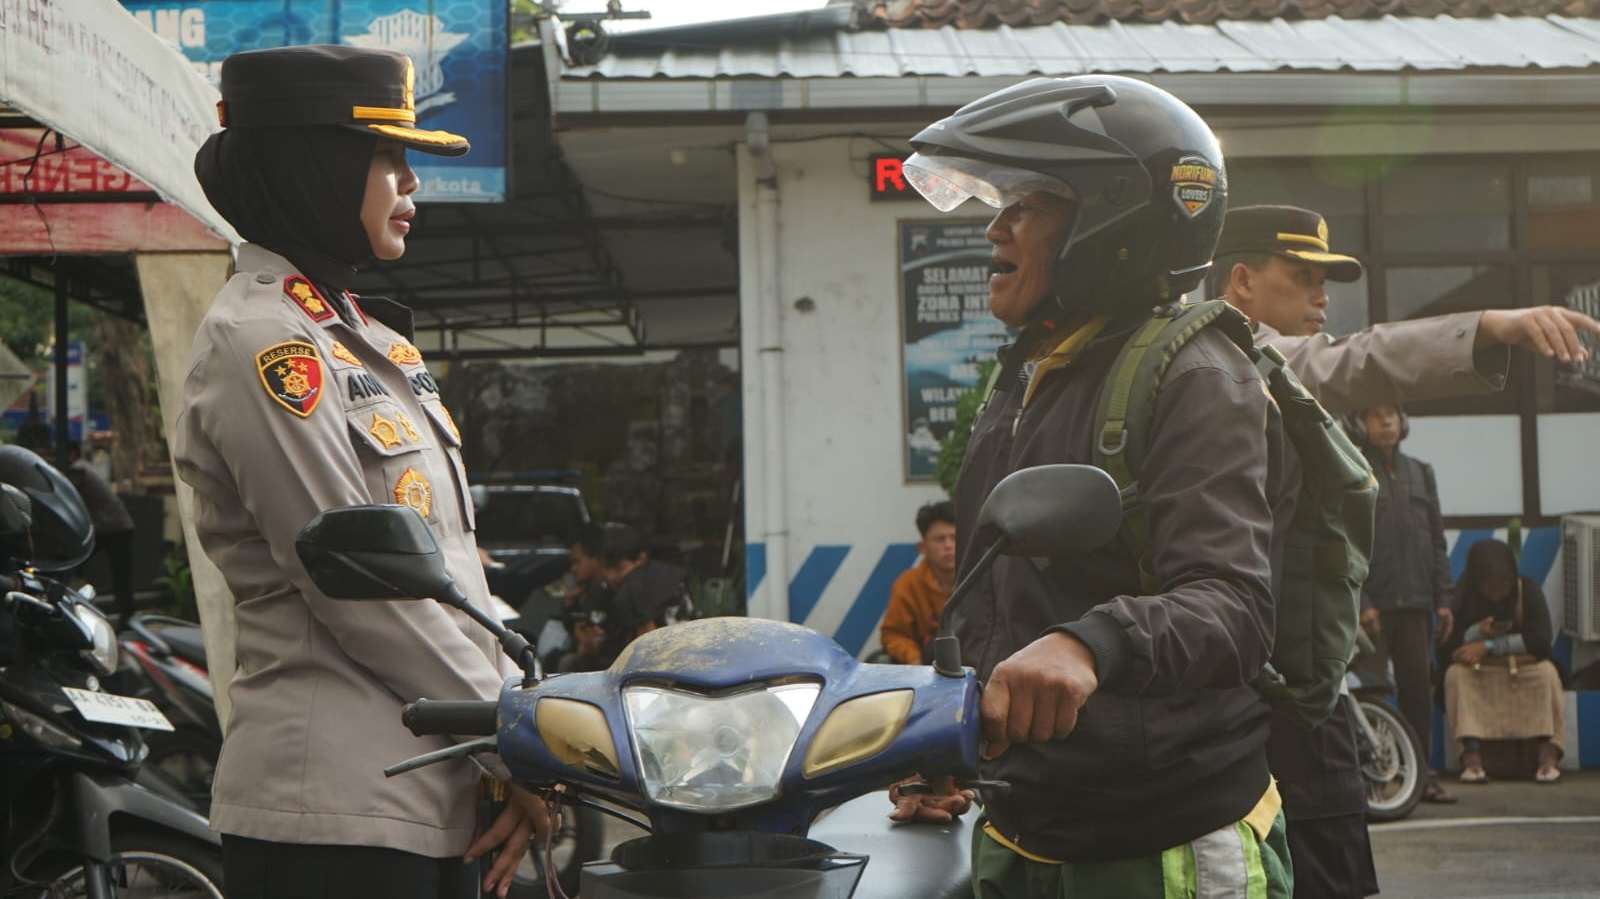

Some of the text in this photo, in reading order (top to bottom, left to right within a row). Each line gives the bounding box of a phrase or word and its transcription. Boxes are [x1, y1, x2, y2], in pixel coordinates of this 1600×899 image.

[923, 266, 988, 284] SELAMAT
[917, 296, 960, 311] ZONA
[263, 346, 312, 363] RESERSE
